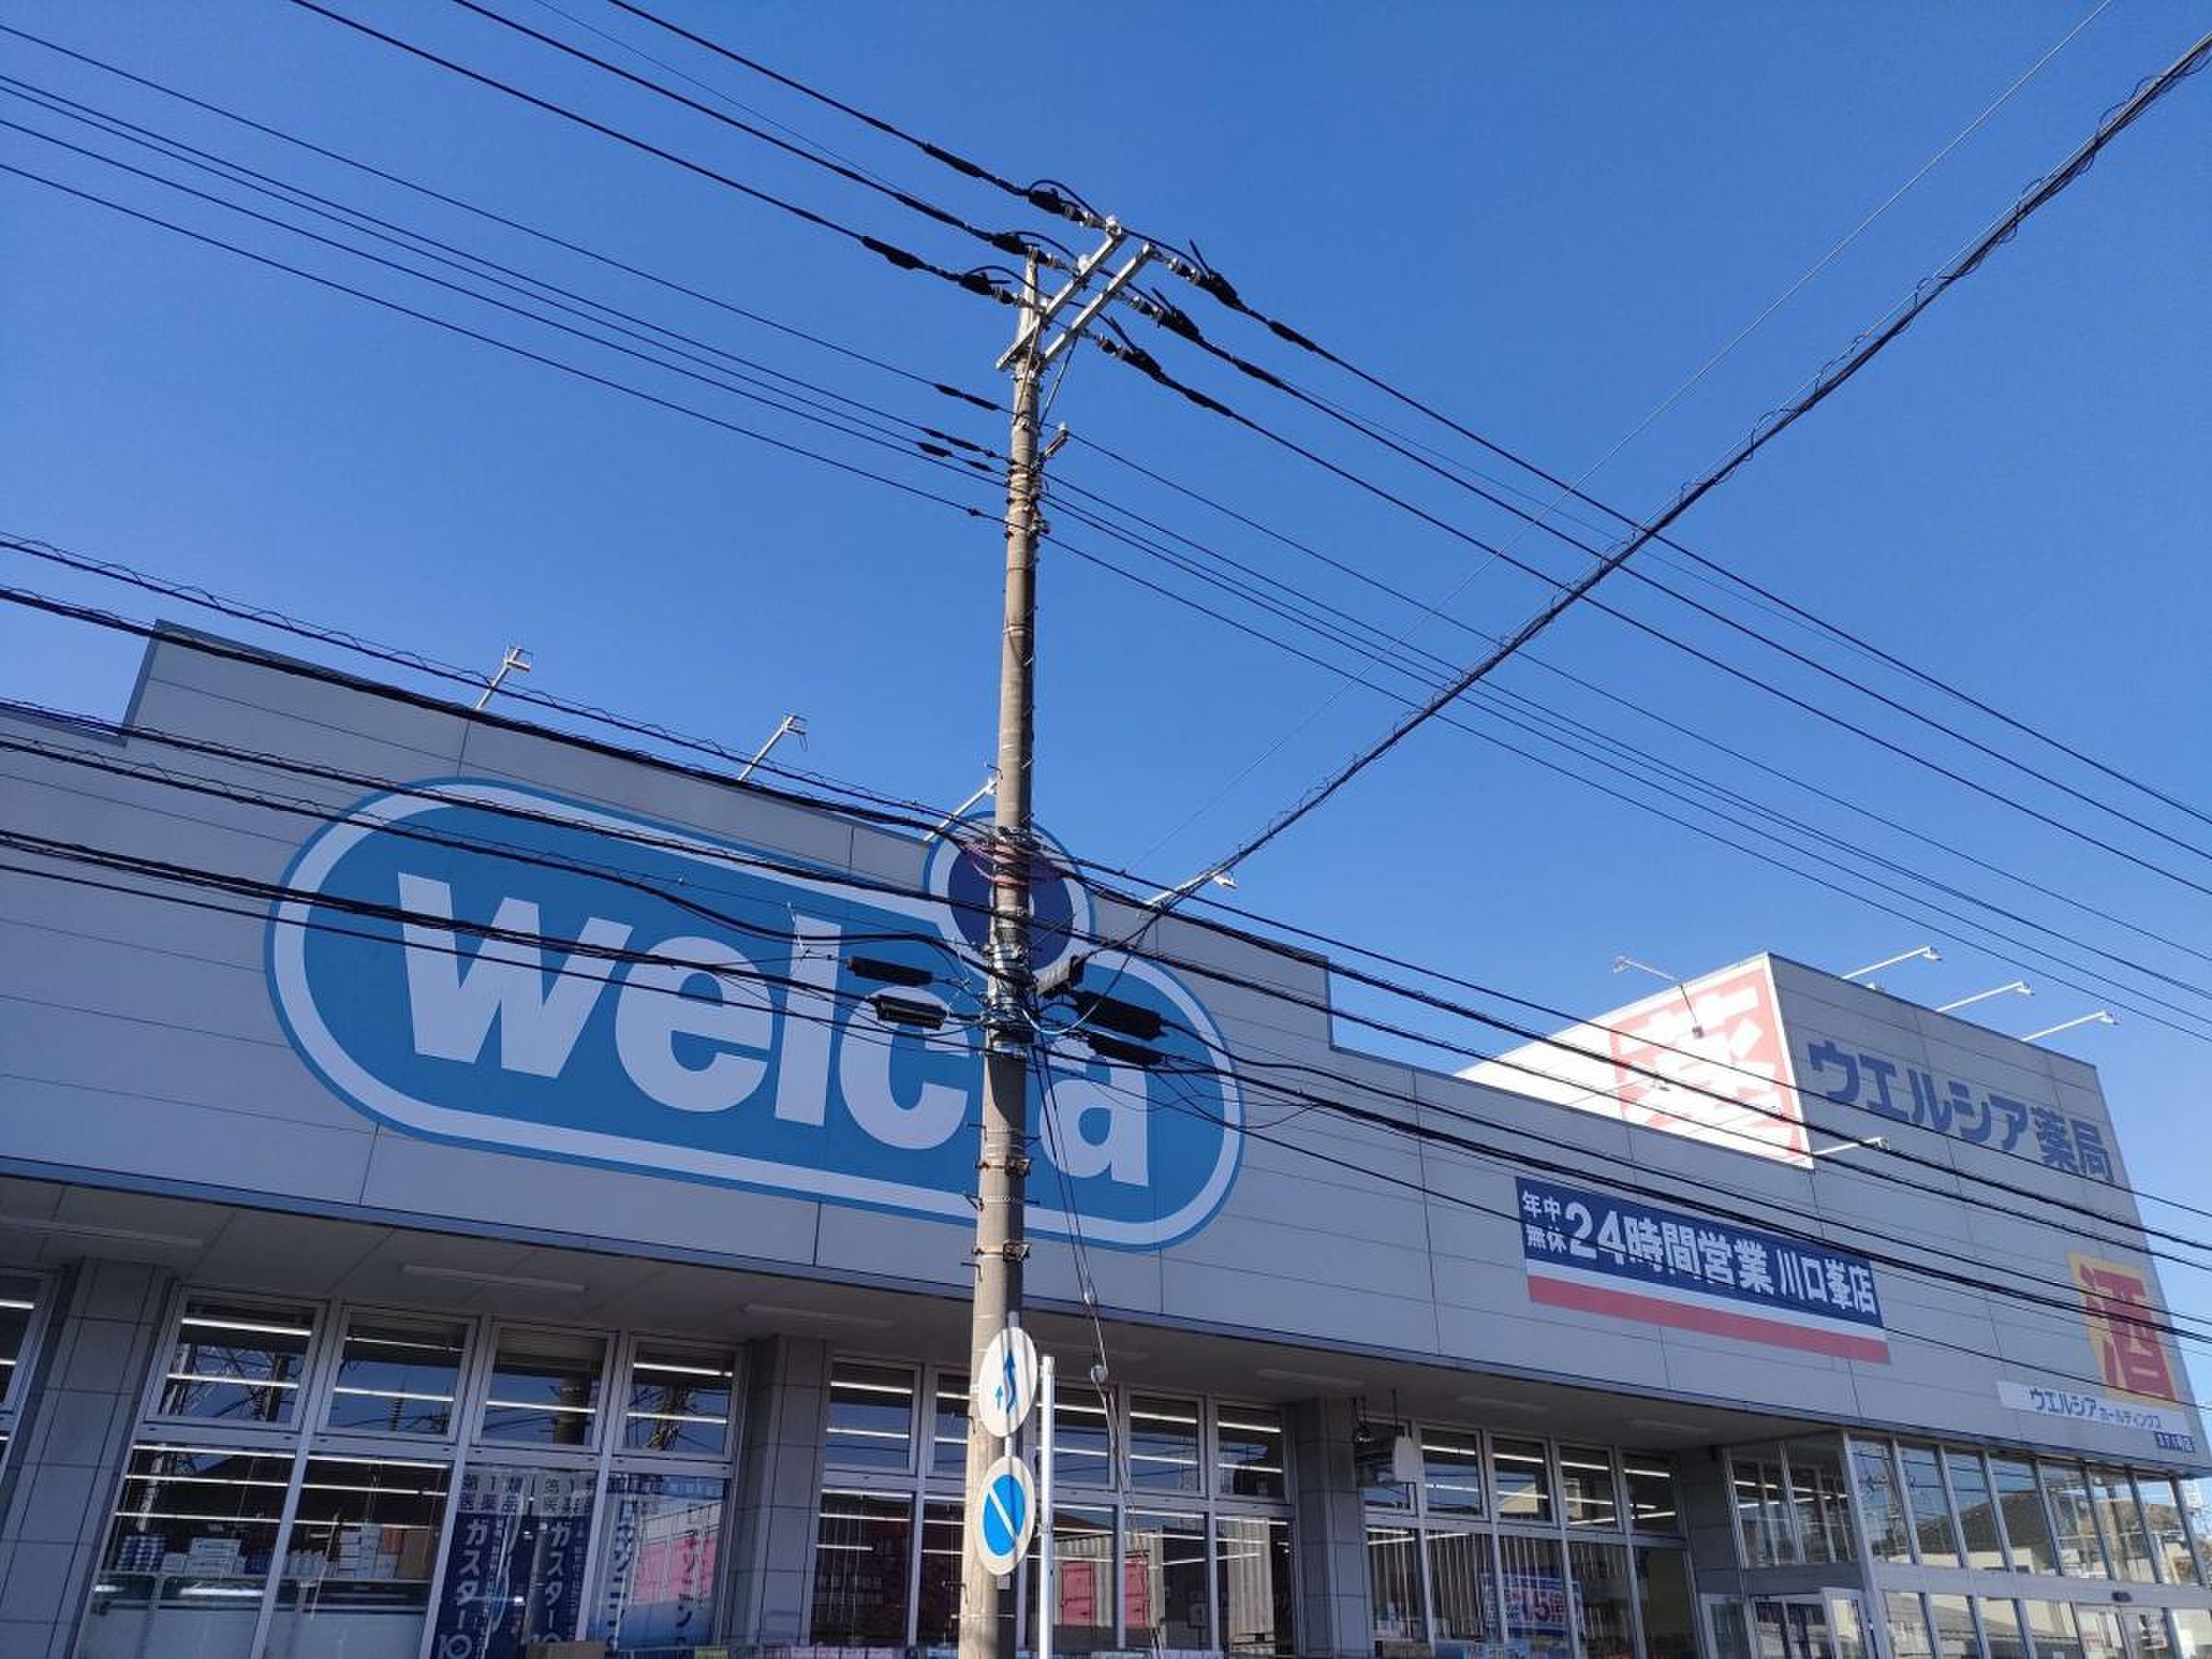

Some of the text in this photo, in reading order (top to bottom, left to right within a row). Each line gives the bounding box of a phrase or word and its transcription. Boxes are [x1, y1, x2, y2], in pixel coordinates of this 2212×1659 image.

[397, 870, 1149, 1187] welca
[1807, 1039, 2116, 1185] ウエルシア薬局
[1522, 1190, 1561, 1220] 年中
[1525, 1226, 1568, 1253] 無休
[1566, 1201, 1775, 1295] 24時間営業
[2078, 1262, 2177, 1402] 酒
